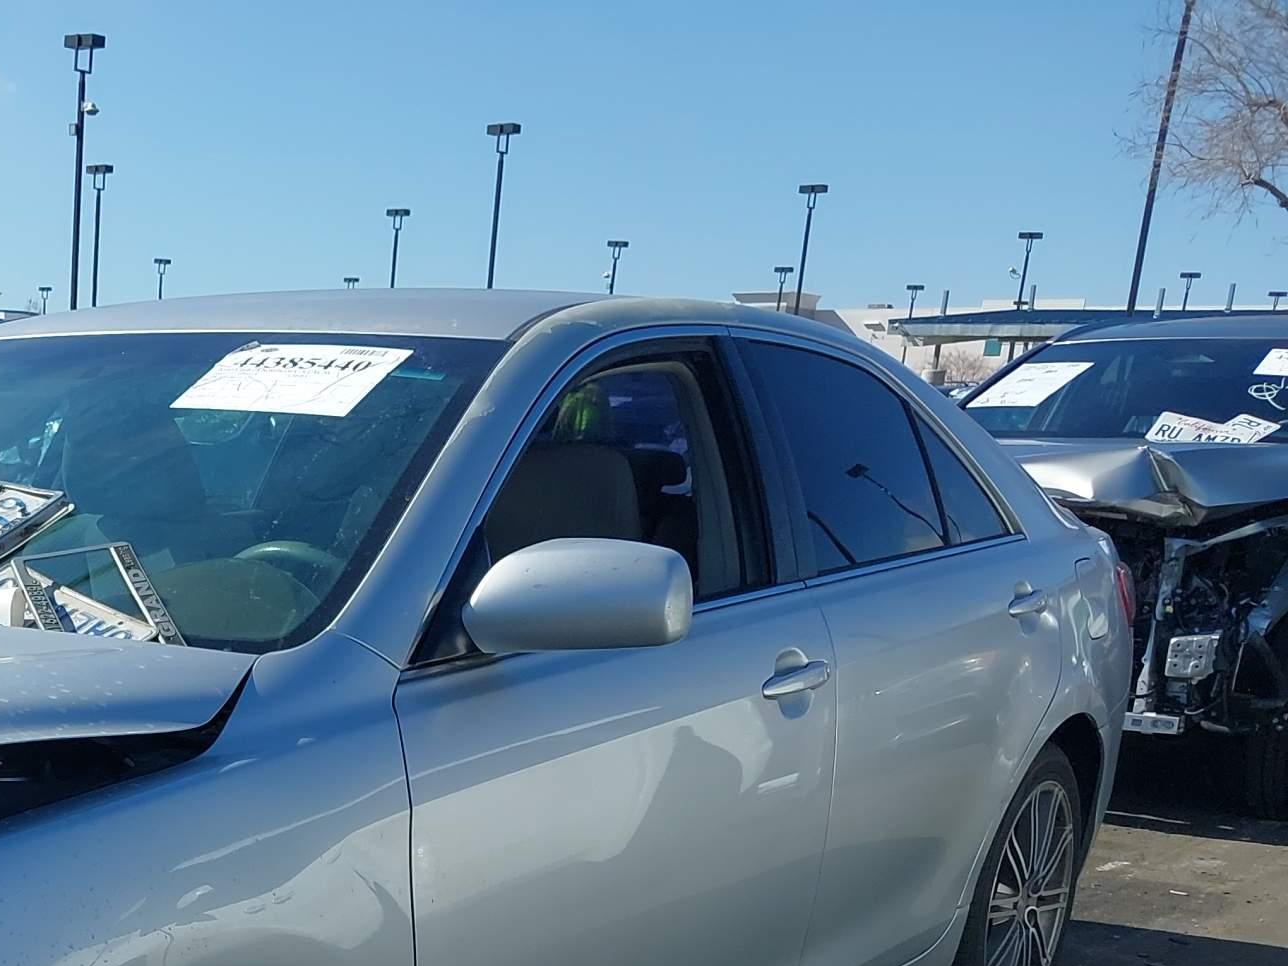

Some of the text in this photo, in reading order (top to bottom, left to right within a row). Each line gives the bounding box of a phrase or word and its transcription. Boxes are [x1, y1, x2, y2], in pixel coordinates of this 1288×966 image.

[236, 356, 373, 372] 44385440
[1155, 424, 1183, 440] RU
[128, 568, 176, 637] GRAND
